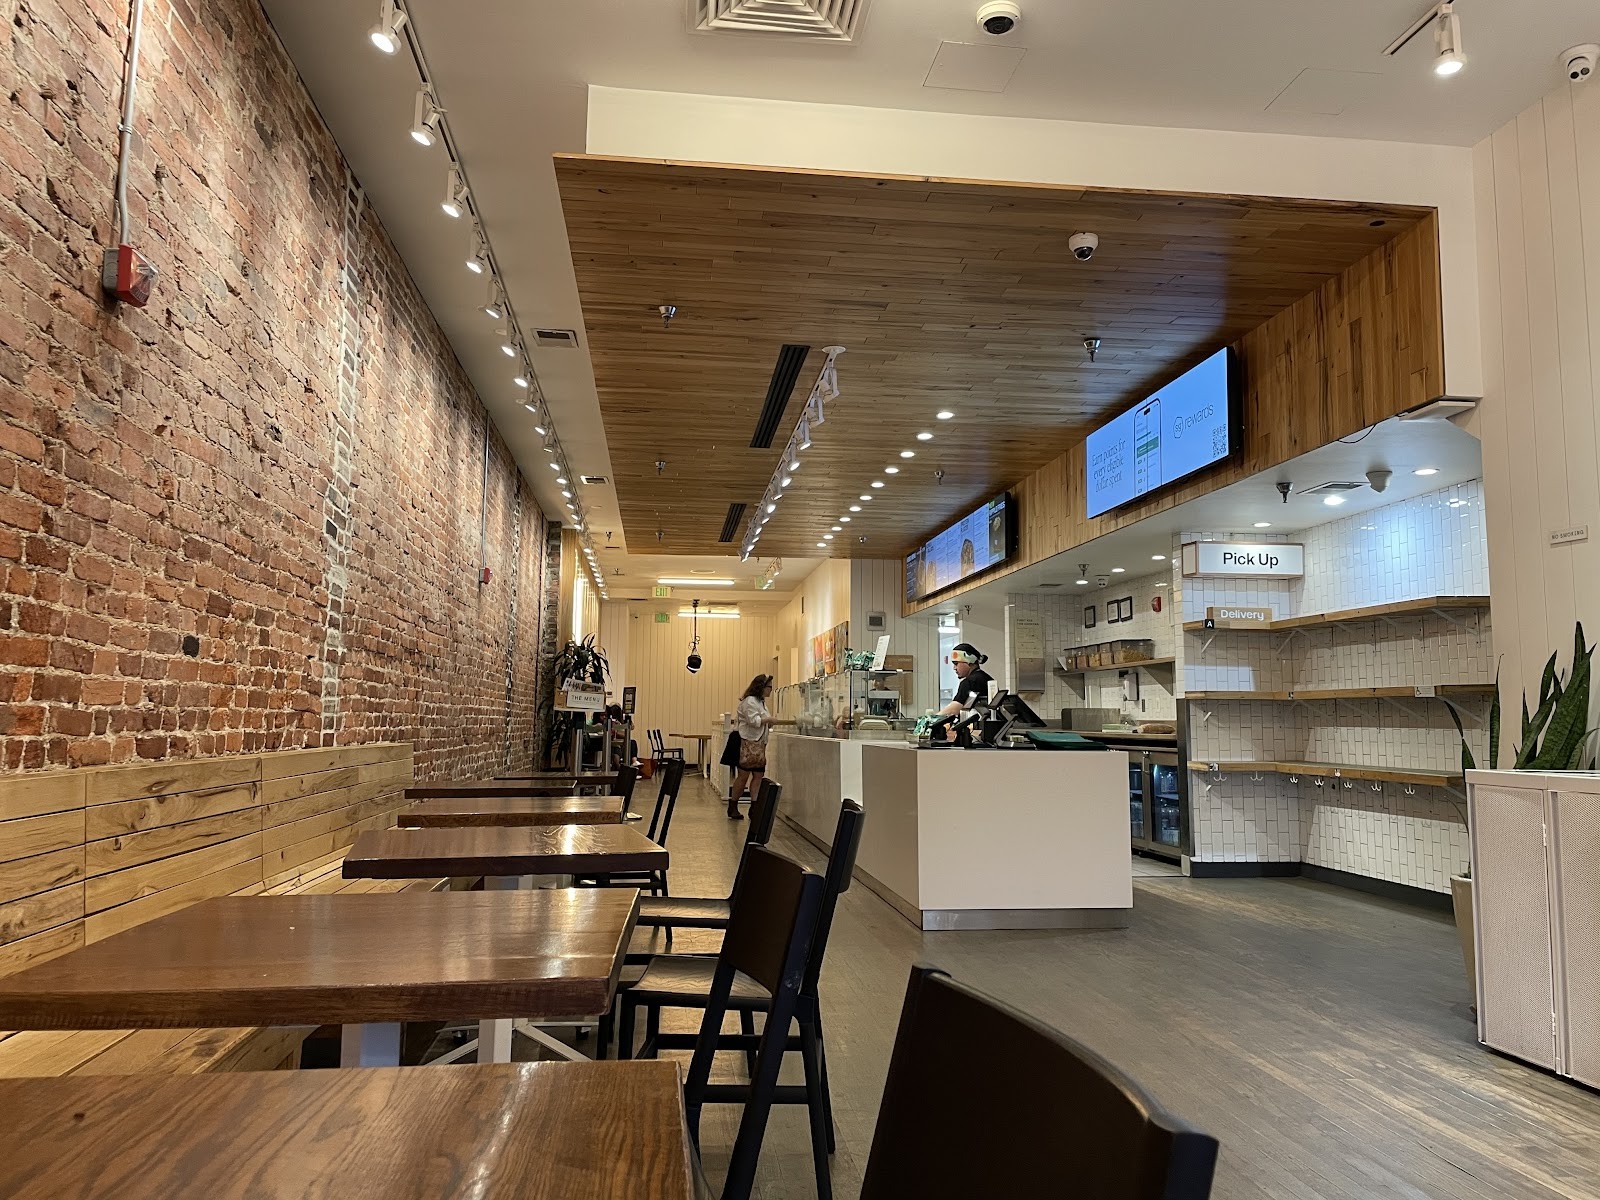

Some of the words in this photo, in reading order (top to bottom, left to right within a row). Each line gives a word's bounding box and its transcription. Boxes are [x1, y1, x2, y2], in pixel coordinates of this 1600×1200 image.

[1185, 403, 1214, 430] rewards
[1092, 453, 1103, 467] Earn
[1103, 445, 1118, 464] points
[1223, 552, 1255, 566] Pick
[1258, 553, 1279, 569] Up
[655, 587, 668, 597] EXIT
[1220, 609, 1265, 621] Delivery
[1206, 620, 1213, 628] A
